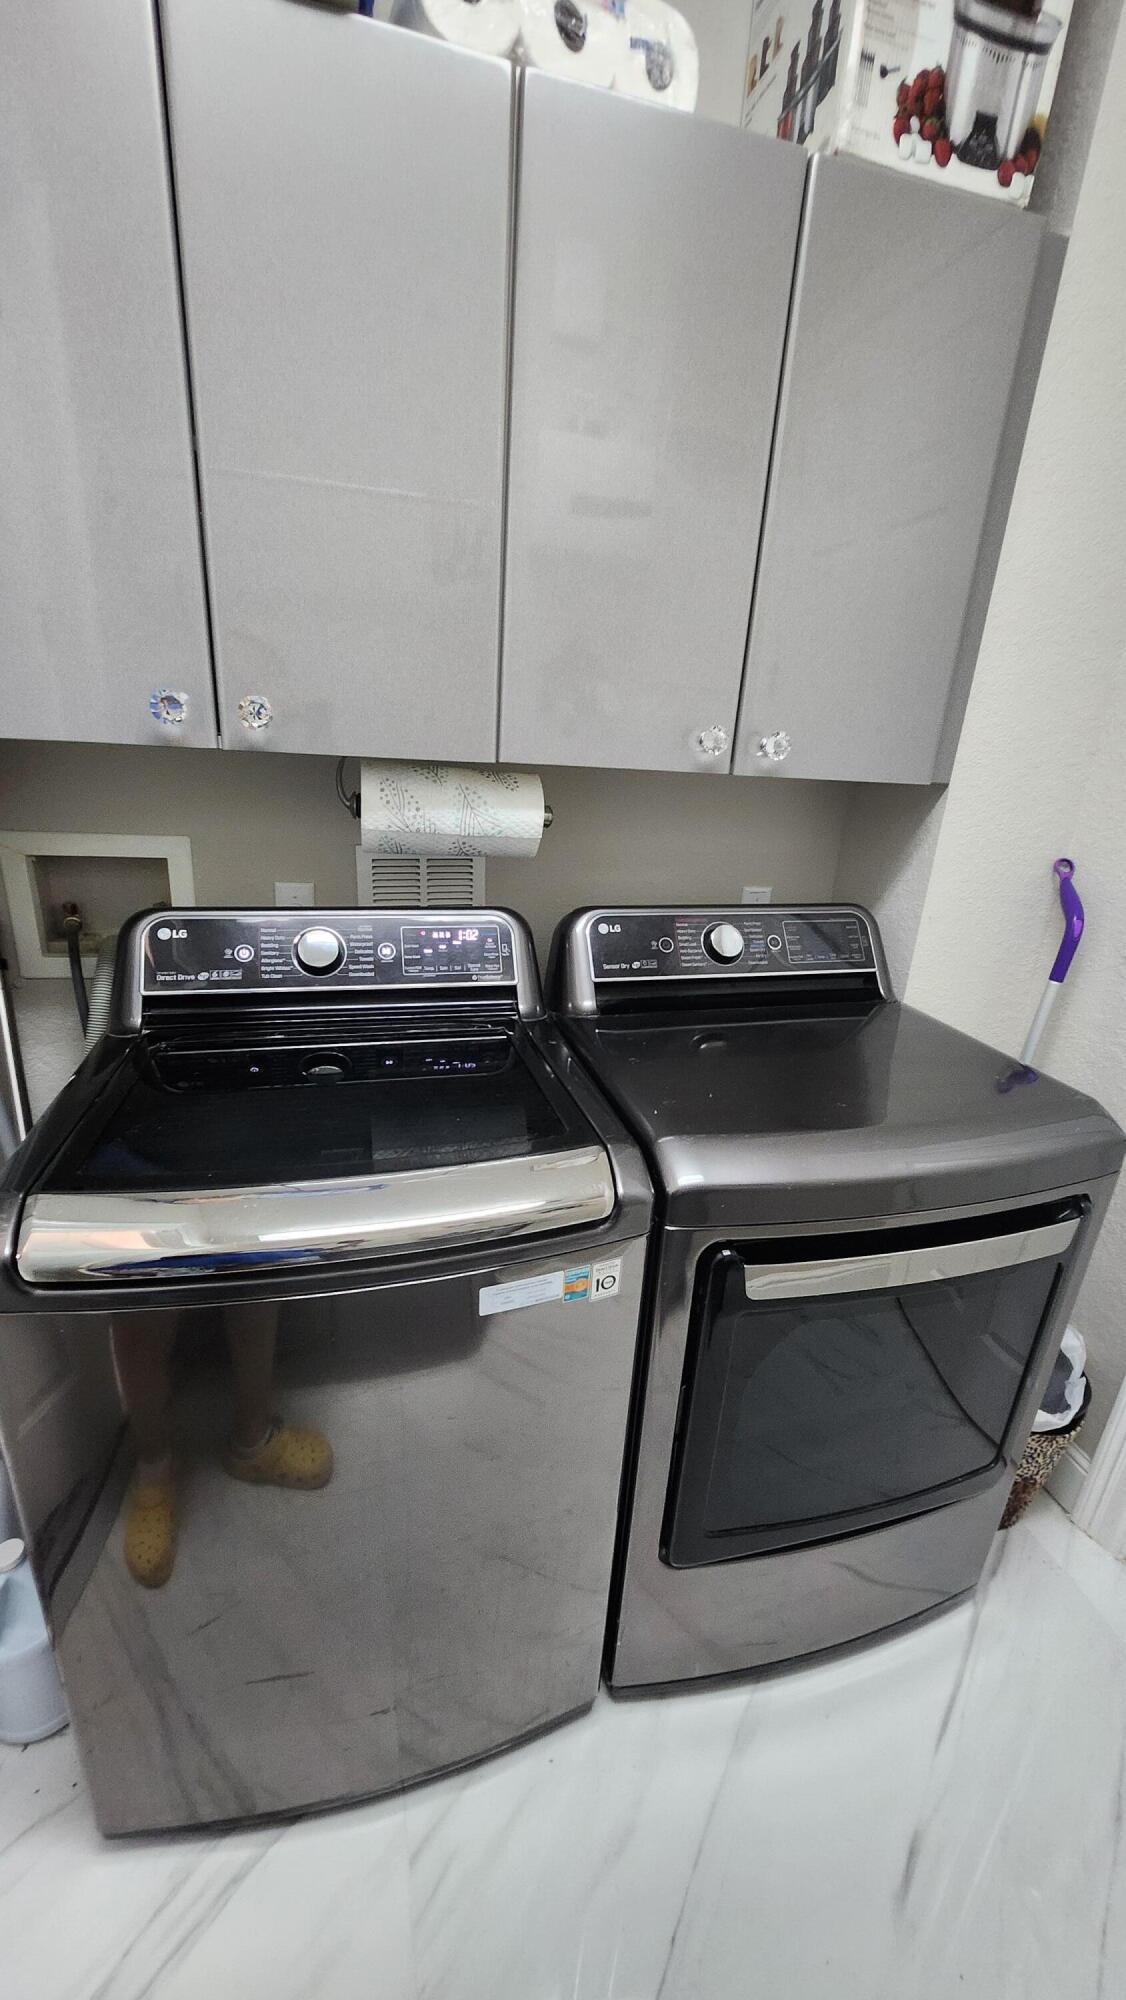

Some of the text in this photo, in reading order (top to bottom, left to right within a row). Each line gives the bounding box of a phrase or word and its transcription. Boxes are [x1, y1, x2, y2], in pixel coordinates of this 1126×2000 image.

[609, 924, 621, 933] LG
[172, 929, 188, 939] LG
[458, 929, 479, 941] 1:02
[620, 962, 630, 970] Dry
[595, 1275, 617, 1292] 10
